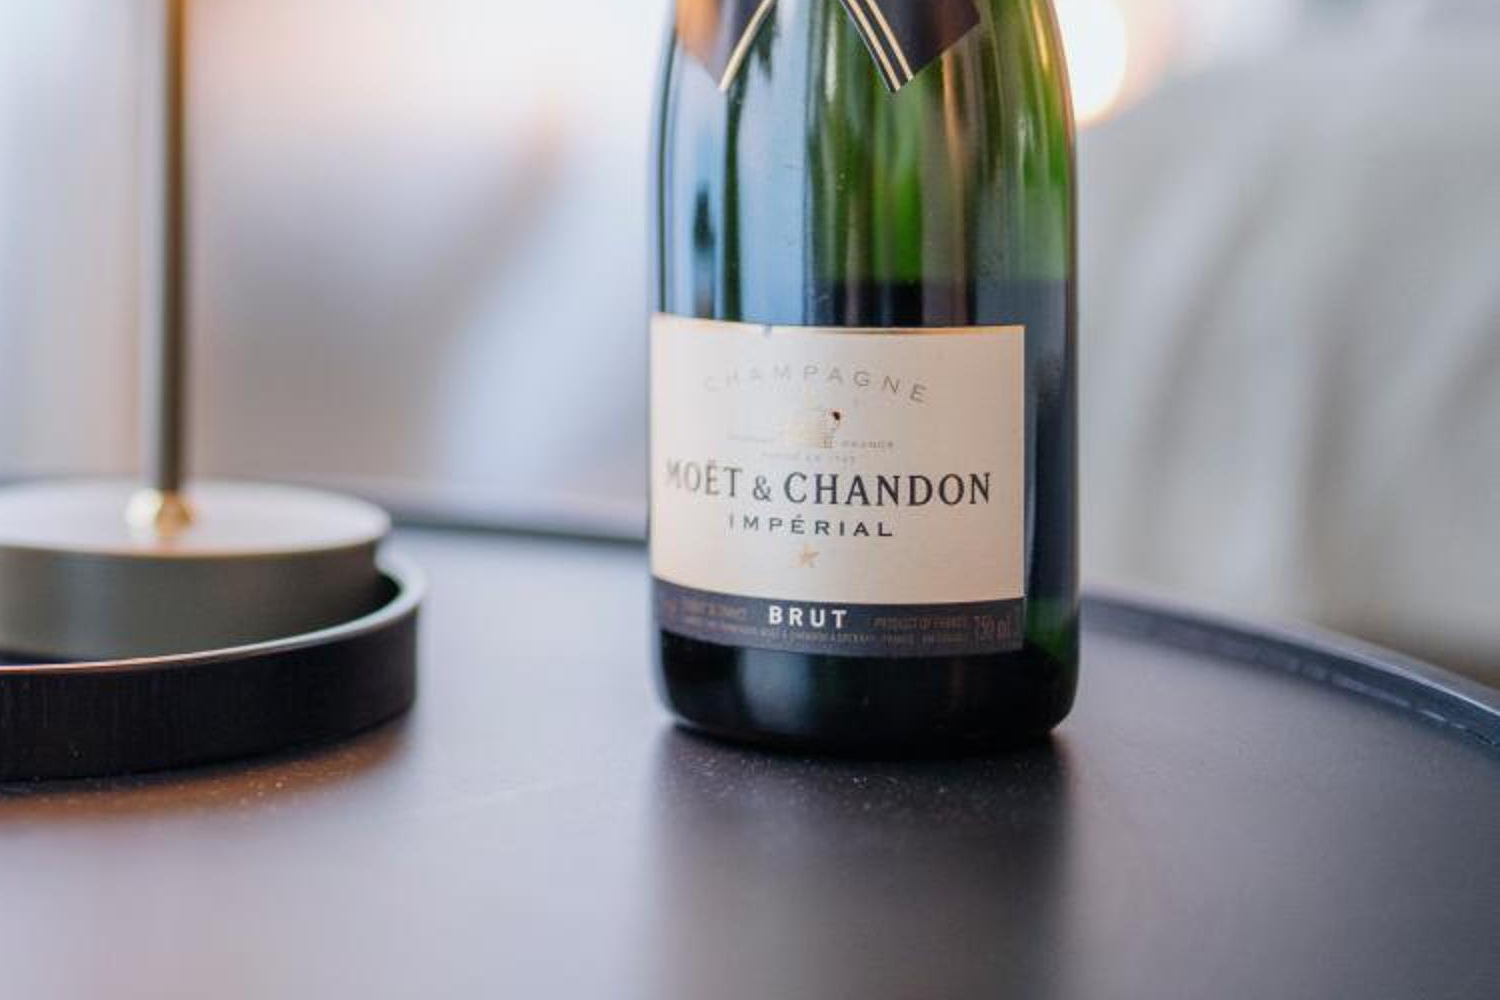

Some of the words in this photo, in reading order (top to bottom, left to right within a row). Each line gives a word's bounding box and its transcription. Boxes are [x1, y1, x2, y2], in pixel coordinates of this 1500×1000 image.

[703, 365, 928, 403] CHAMPAGNE
[666, 458, 743, 499] MOËT
[752, 474, 772, 502] &
[783, 471, 992, 507] CHANDON
[729, 513, 894, 537] IMPÉRIAL
[768, 604, 848, 629] BRUT
